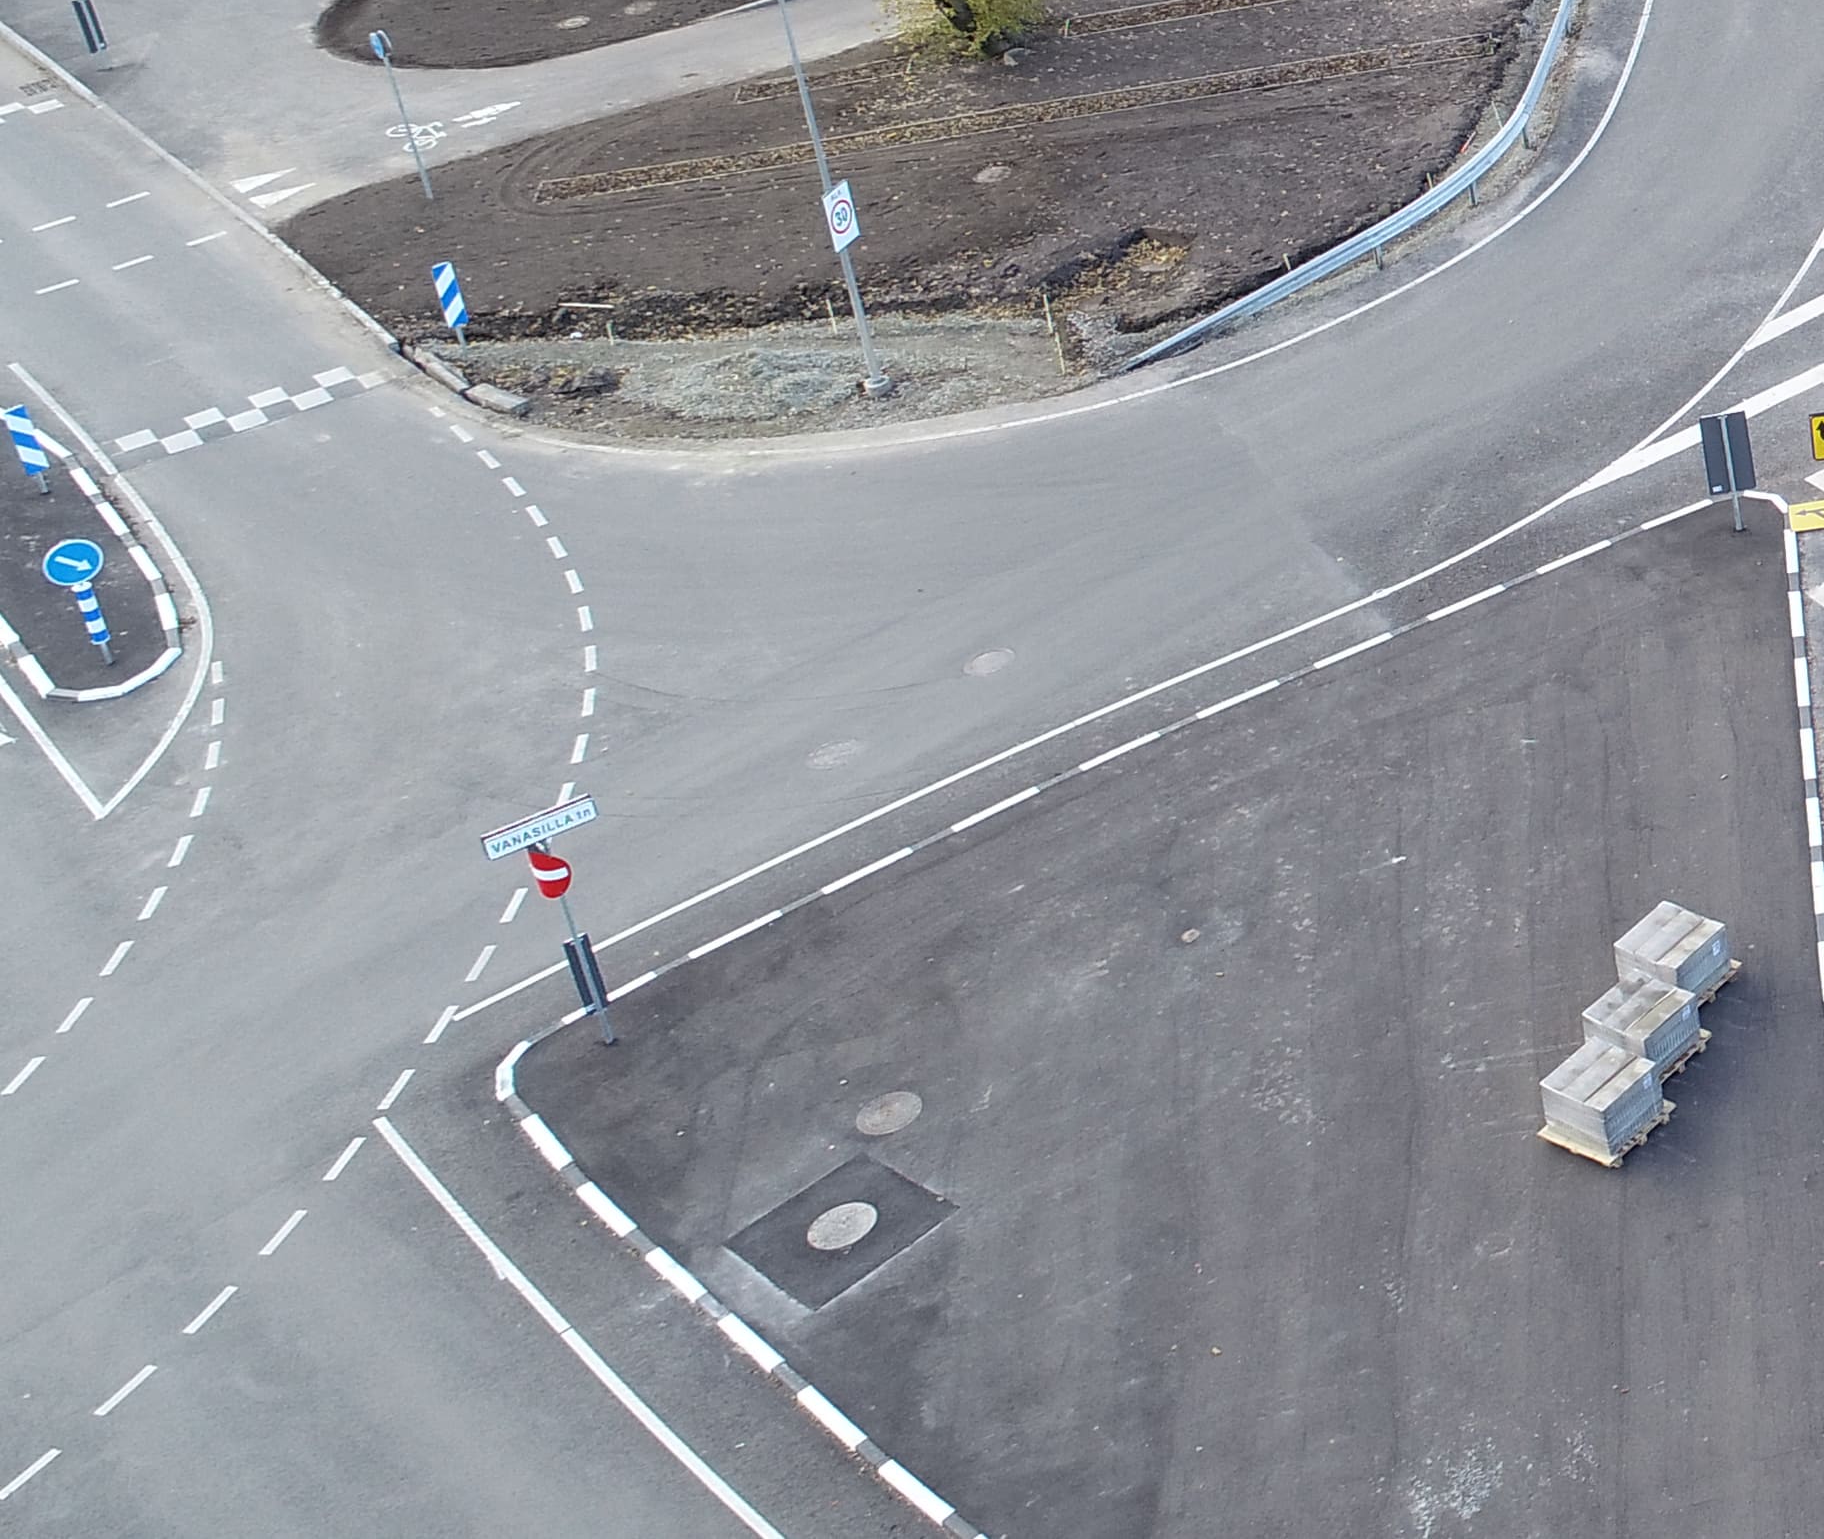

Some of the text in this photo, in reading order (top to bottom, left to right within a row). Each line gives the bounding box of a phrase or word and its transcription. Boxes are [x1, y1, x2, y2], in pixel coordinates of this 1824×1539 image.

[835, 207, 848, 227] 30
[491, 807, 592, 853] VANASILLA tn
